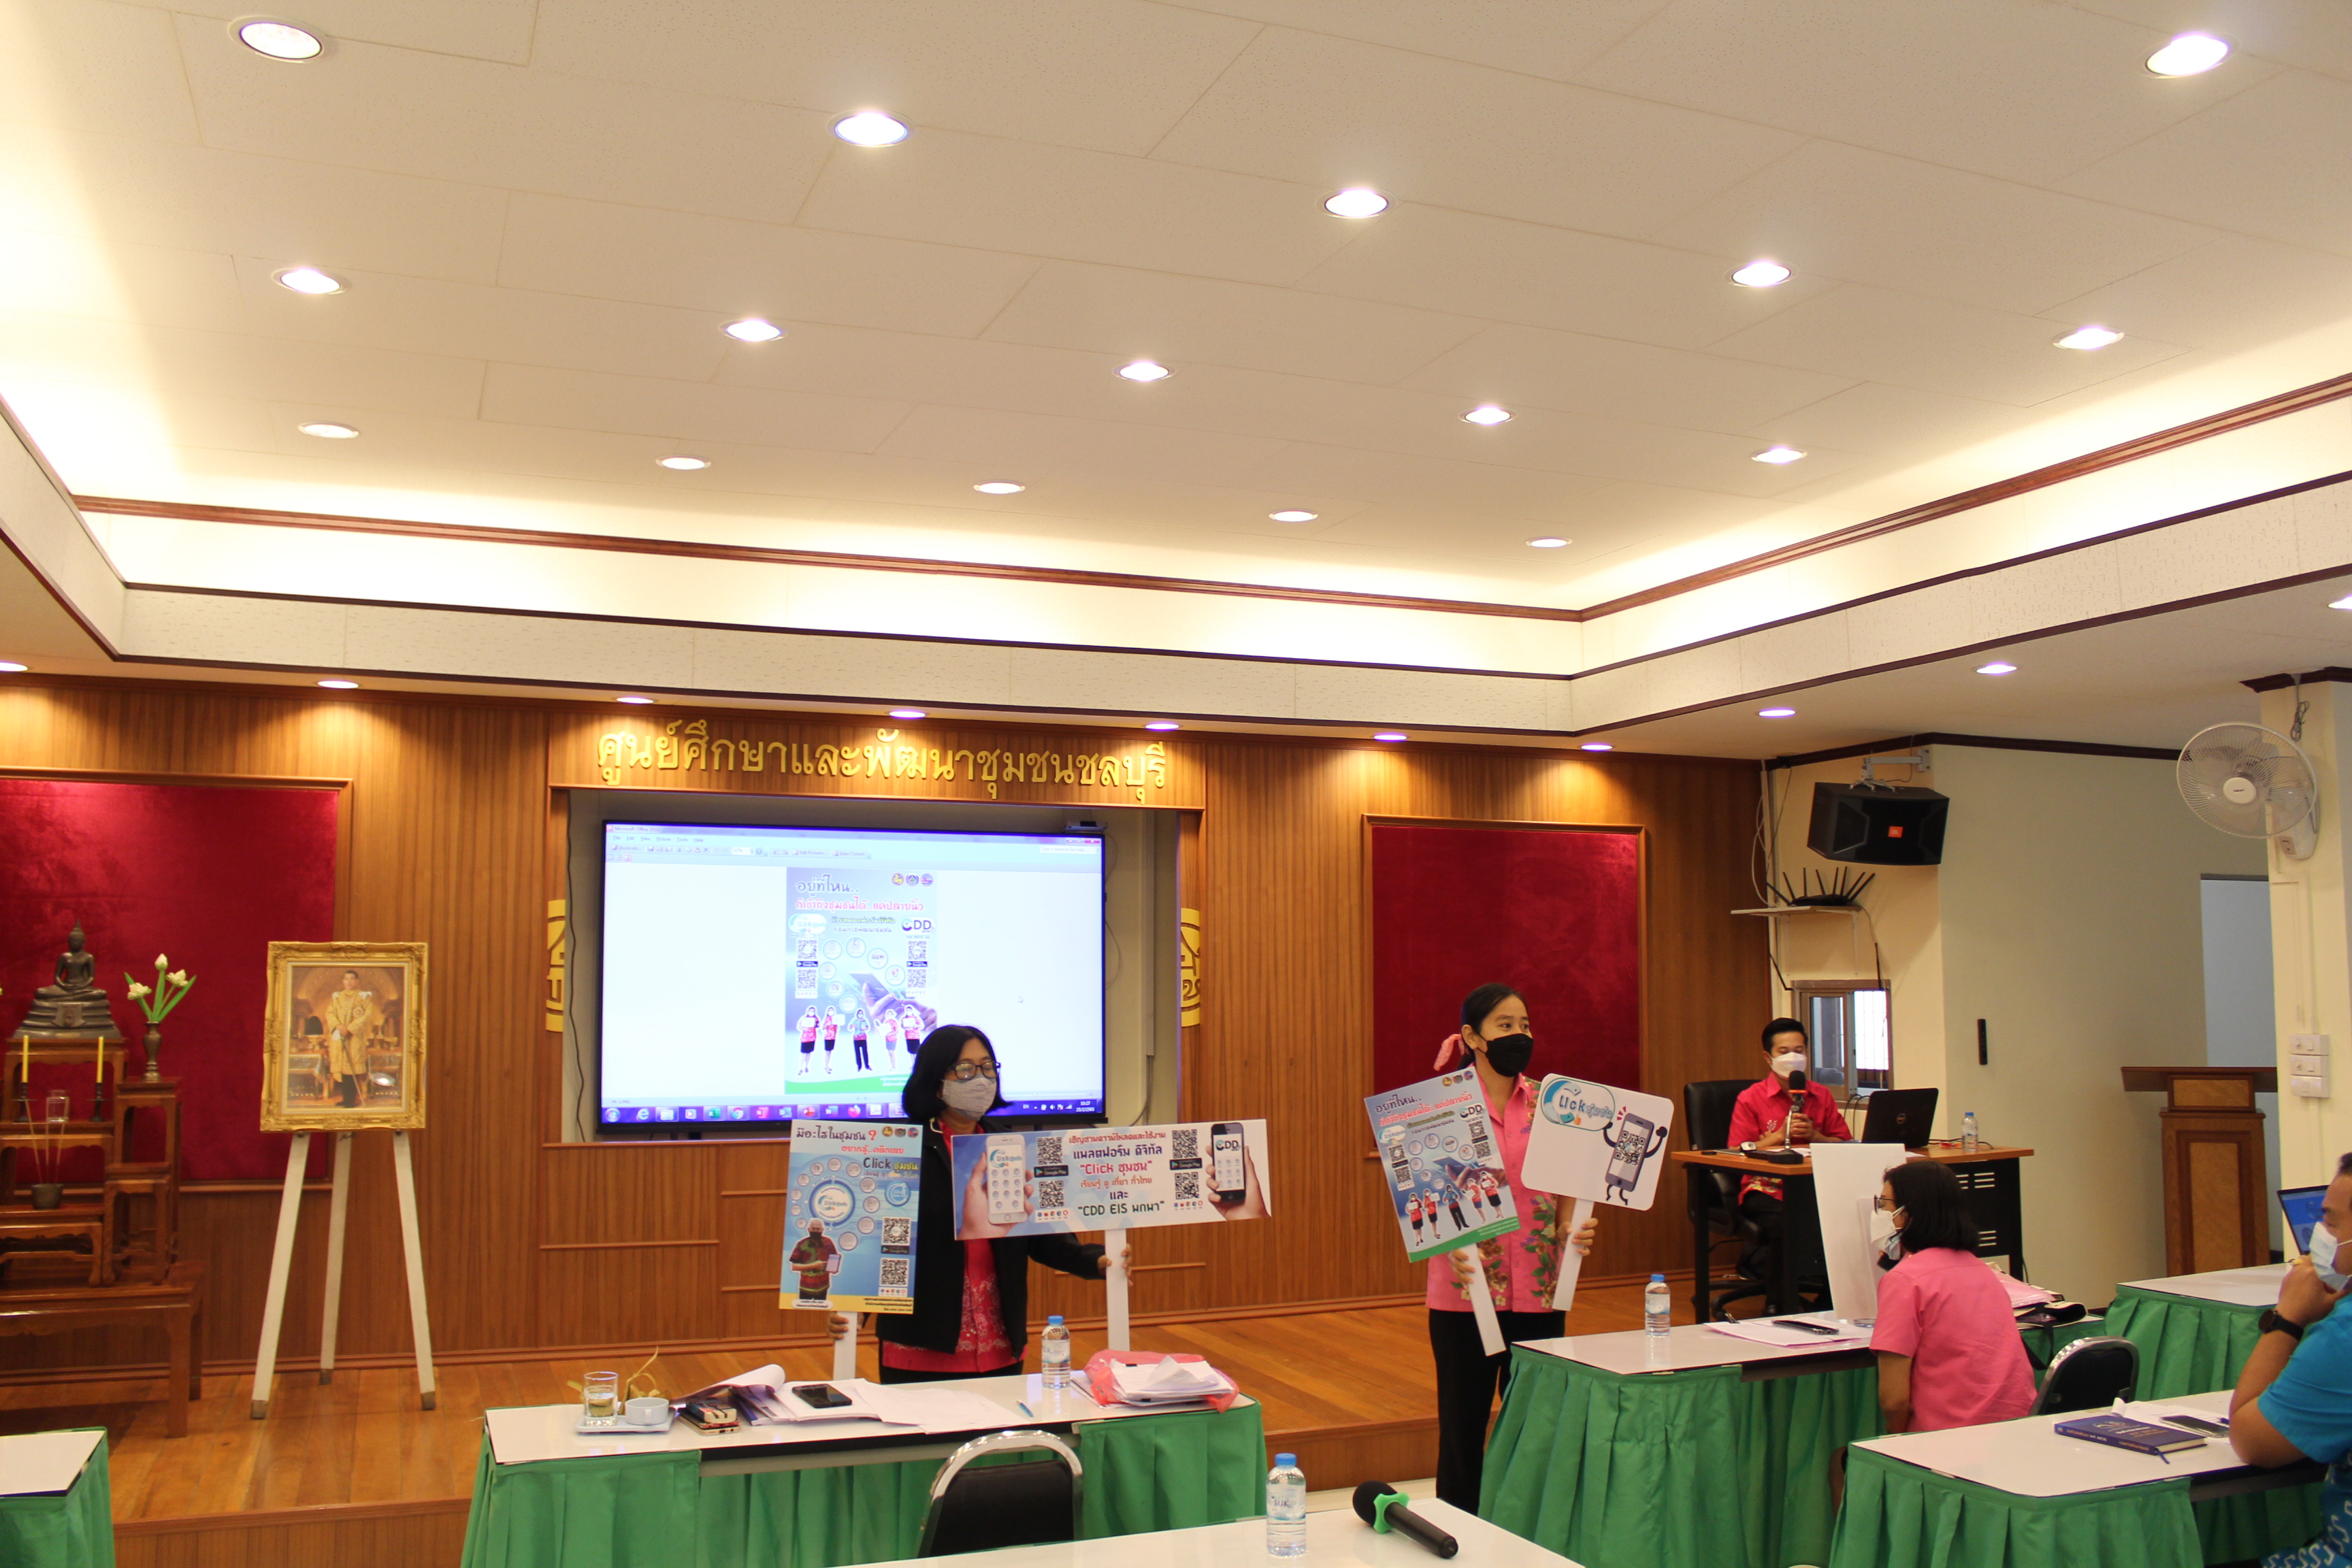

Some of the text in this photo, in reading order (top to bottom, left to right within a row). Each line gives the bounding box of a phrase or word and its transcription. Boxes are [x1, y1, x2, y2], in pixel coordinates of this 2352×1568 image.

[597, 719, 1166, 805] ศูนย์ศึกษาและพัฒนาชุมชนชลบุรี
[1073, 1143, 1162, 1159] แพลตฟอร์ม ดิจิทัล
[863, 1158, 919, 1173] Click ชุมชน
[1131, 1174, 1152, 1184] ทั่วไทย
[1110, 1191, 1129, 1200] และ
[1110, 1203, 1128, 1214] EIS
